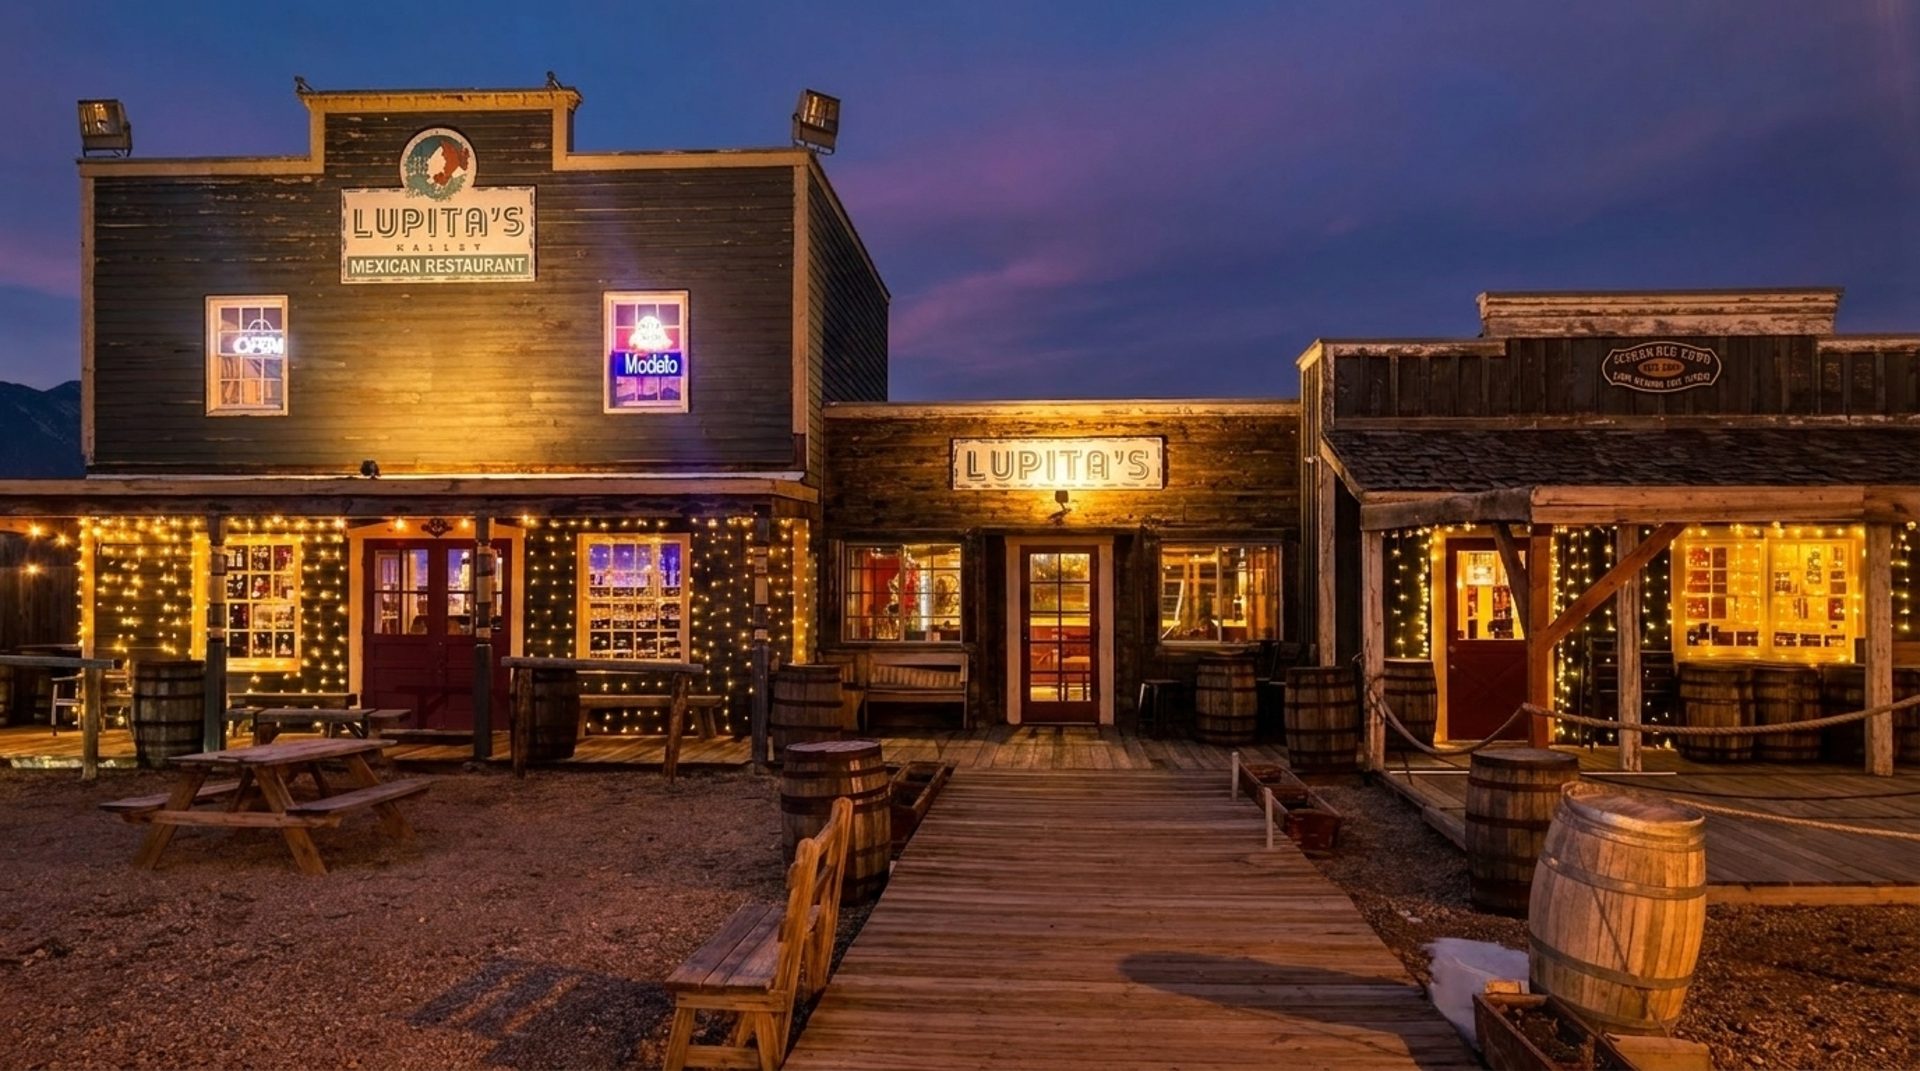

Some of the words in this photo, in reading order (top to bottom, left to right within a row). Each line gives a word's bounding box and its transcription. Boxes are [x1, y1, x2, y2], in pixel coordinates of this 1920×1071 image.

[353, 207, 525, 239] LUPITA'S
[350, 258, 421, 274] MEXICAN
[425, 257, 525, 274] RESTAURANT
[966, 449, 1150, 481] LUPITA'S
